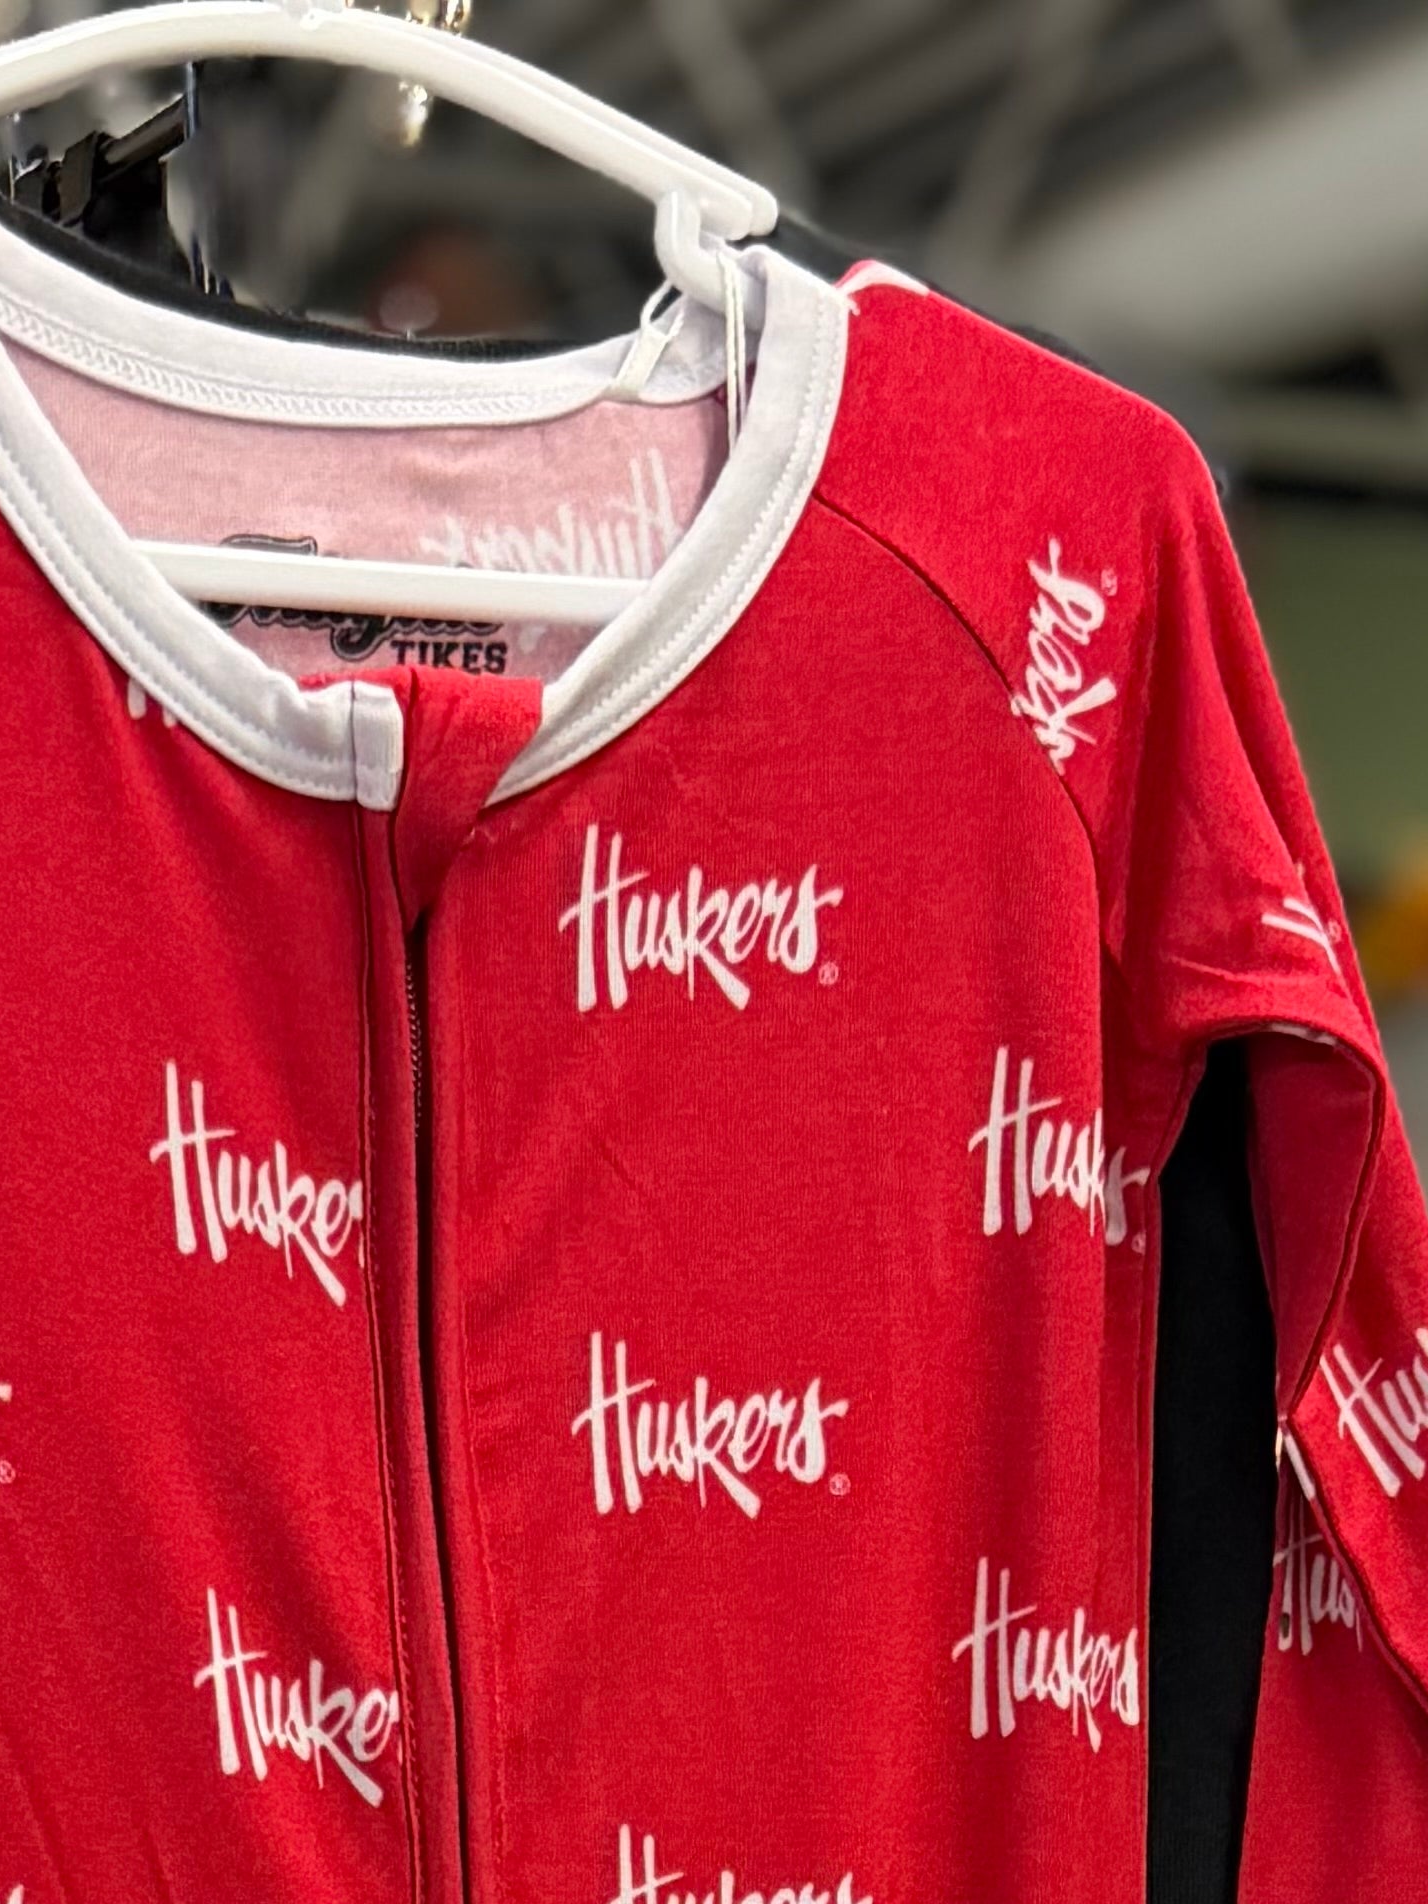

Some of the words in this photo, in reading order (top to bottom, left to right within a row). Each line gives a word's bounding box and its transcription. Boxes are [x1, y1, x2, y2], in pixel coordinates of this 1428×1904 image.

[390, 640, 508, 674] TIKES
[556, 822, 845, 1014] Huskers
[148, 1060, 366, 1308] Huske
[570, 1330, 850, 1520] Huskers
[192, 1586, 401, 1809] Huske
[950, 1556, 1142, 1754] Huskers
